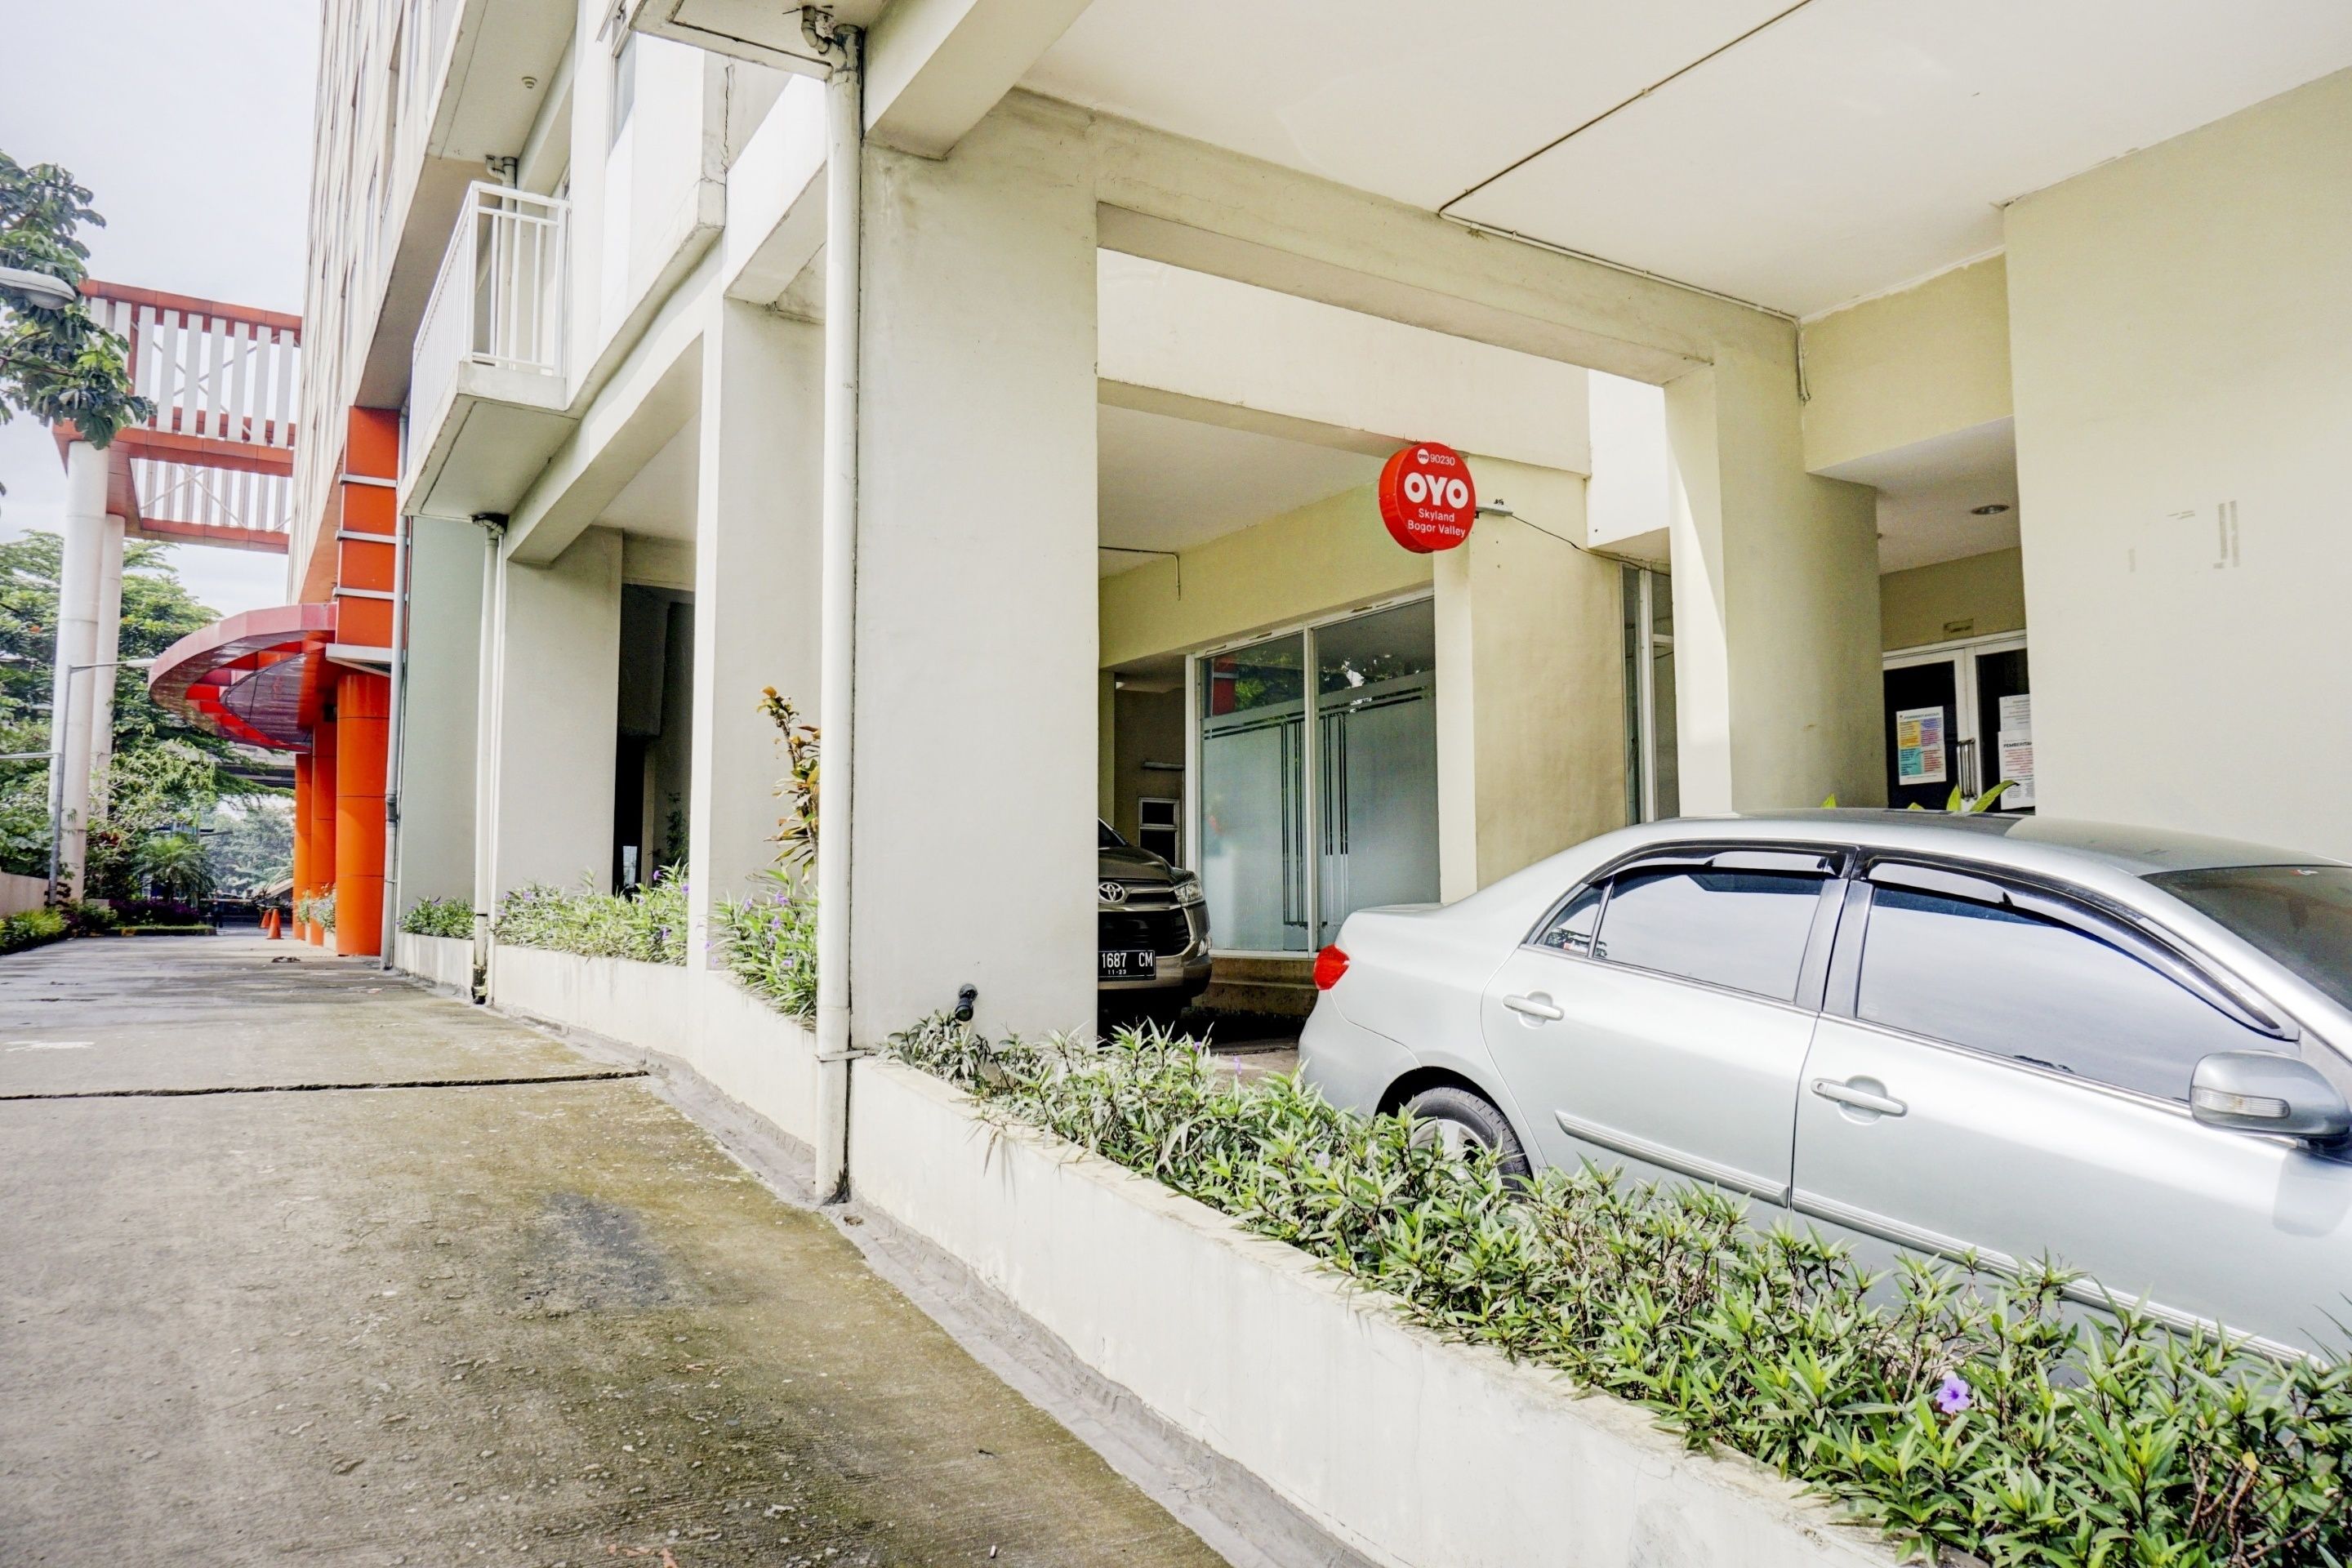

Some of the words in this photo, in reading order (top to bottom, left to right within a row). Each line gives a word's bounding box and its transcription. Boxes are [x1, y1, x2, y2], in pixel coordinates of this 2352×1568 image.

[1430, 453, 1455, 466] 90230
[1404, 472, 1468, 509] OYO
[1419, 508, 1454, 522] Skyland
[1408, 519, 1436, 533] Bogor
[1438, 523, 1465, 537] Valley
[1102, 952, 1127, 969] 1687
[1138, 951, 1153, 967] CM
